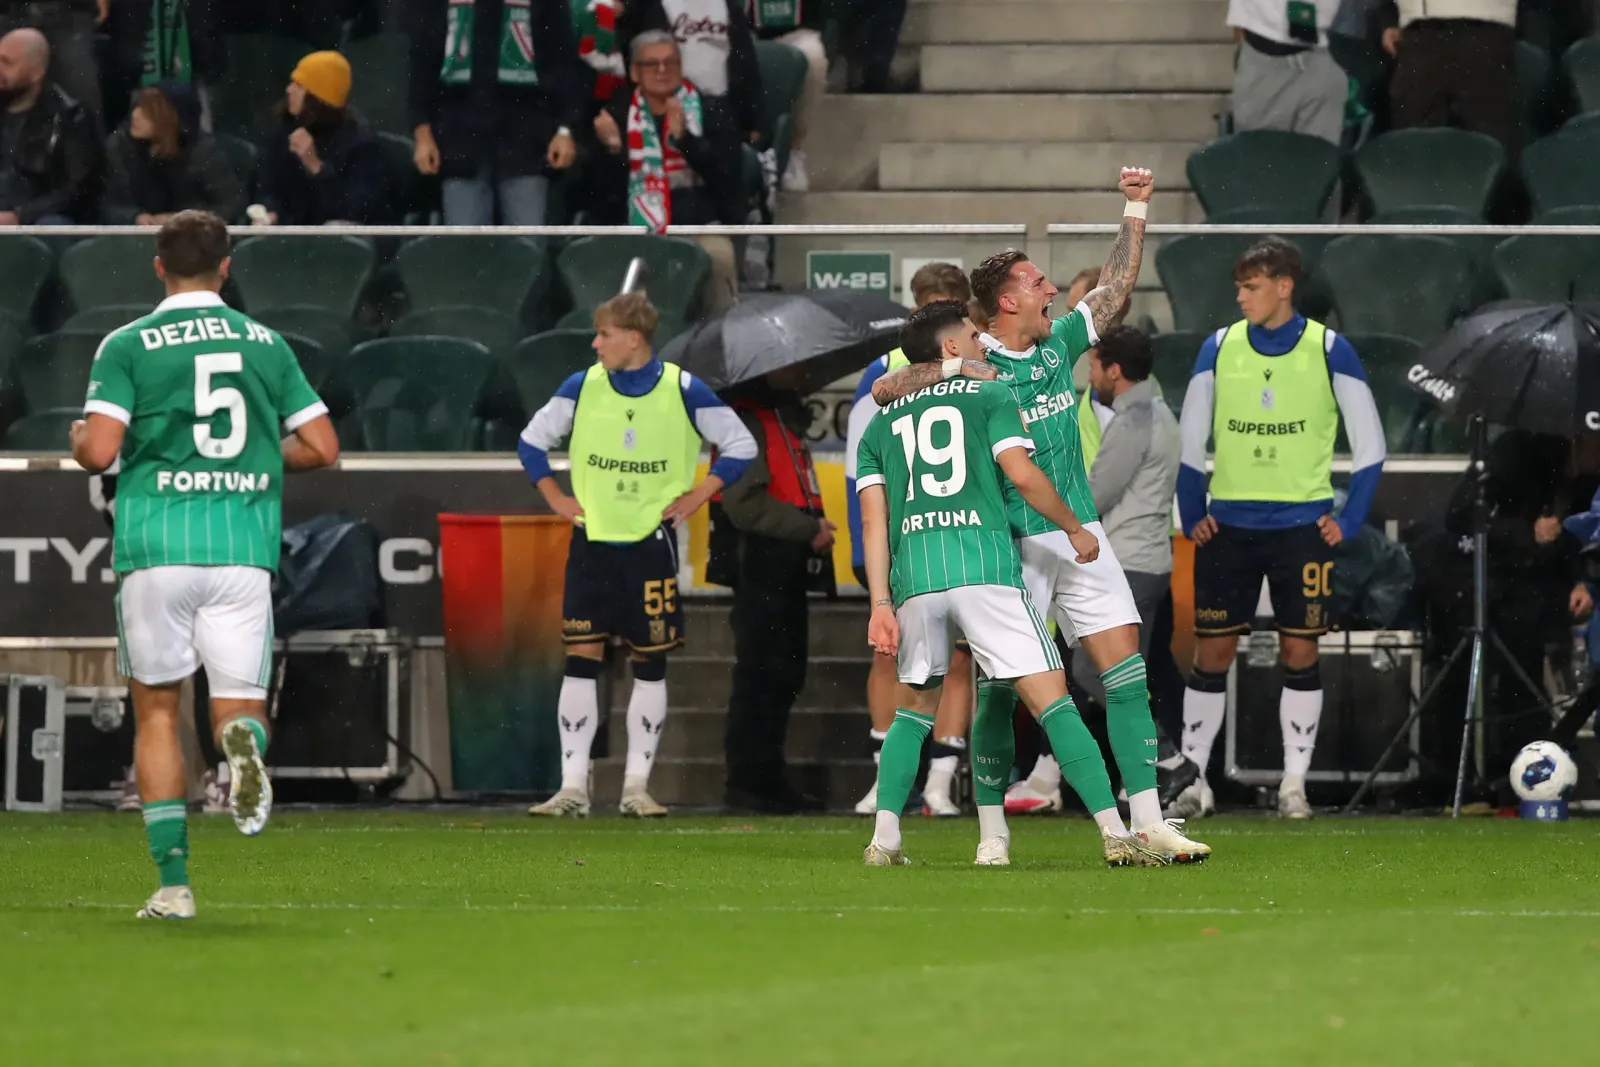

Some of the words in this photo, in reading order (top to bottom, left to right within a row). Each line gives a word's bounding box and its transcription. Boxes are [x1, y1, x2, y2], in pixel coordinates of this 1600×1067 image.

[813, 272, 888, 290] W-25
[140, 317, 241, 350] DEZIEL
[244, 321, 273, 345] JR
[194, 352, 247, 459] 5
[882, 379, 982, 416] VINAGRE
[1227, 418, 1306, 435] SUPERBET
[587, 454, 668, 473] SUPERBET
[891, 405, 967, 502] 19
[157, 470, 270, 493] FORTUNA
[901, 509, 982, 534] ORTUNA
[378, 537, 443, 584] C
[644, 577, 677, 616] 55
[1303, 561, 1334, 598] 90
